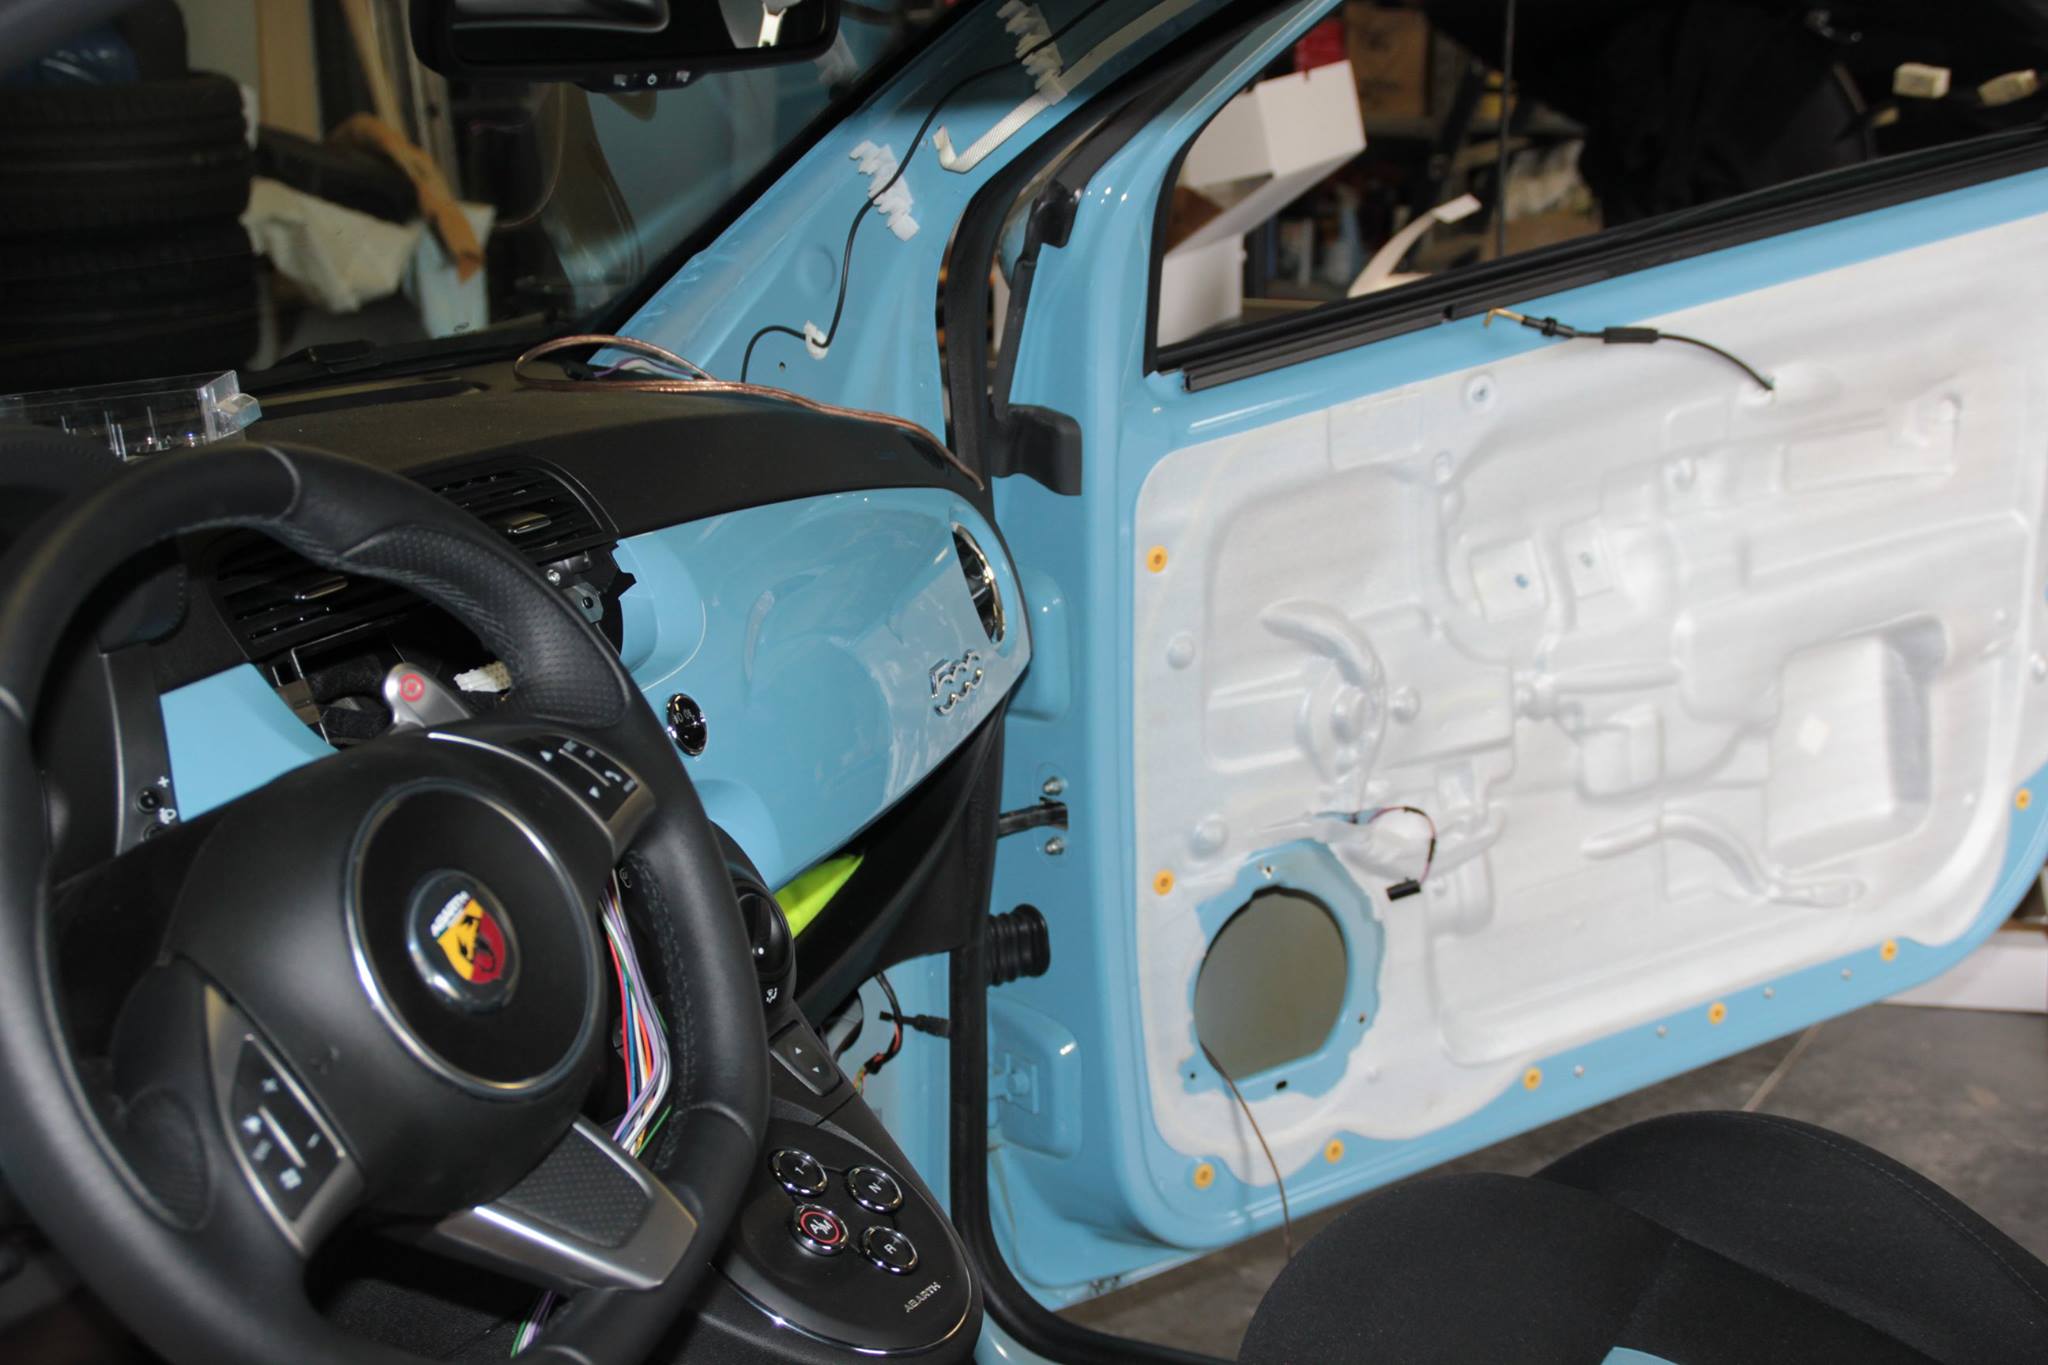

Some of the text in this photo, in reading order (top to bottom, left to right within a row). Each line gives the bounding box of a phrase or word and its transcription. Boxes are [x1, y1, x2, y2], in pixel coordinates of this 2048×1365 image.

[795, 1167, 804, 1175] 1
[867, 1183, 882, 1194] N
[883, 1243, 898, 1255] R
[904, 1281, 941, 1313] ABARTH
